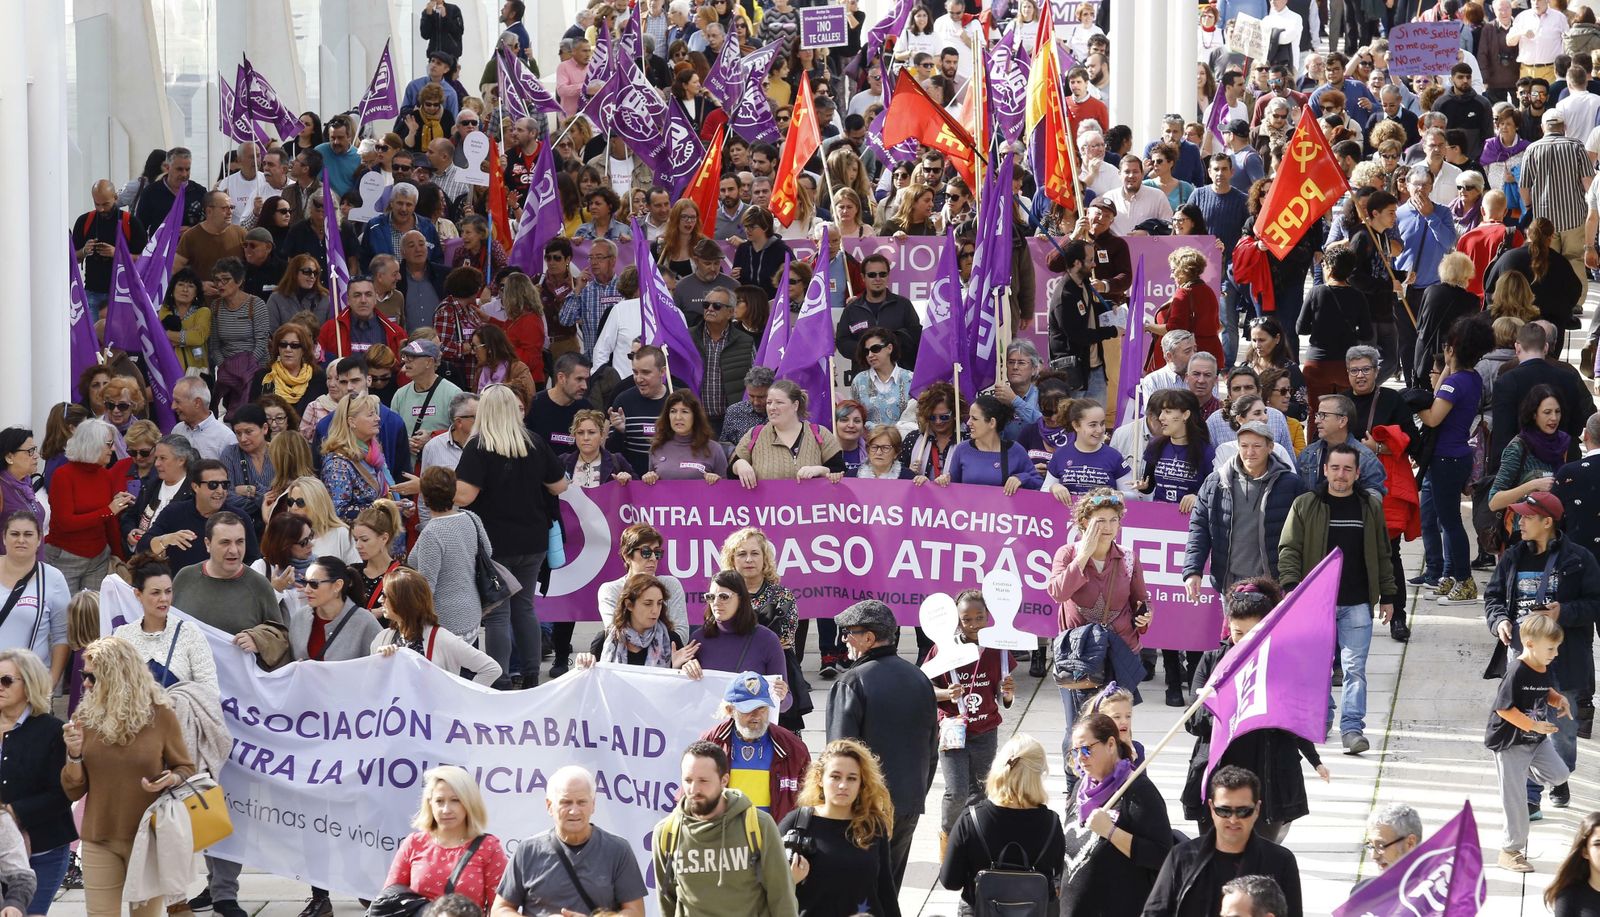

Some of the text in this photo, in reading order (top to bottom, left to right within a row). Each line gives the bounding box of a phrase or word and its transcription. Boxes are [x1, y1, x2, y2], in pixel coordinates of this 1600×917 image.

[816, 20, 831, 32] ¡NO
[1412, 27, 1429, 36] me
[808, 32, 841, 43] TE CALLES!
[1395, 55, 1408, 66] NO
[619, 503, 1054, 539] CONTRA LAS VIOLENCIAS MACHISTAS
[768, 534, 874, 577] ASO
[888, 537, 1053, 590] ATRÁS
[852, 588, 874, 601] LAS
[1156, 588, 1168, 601] la
[221, 697, 666, 758] ASOCIACIÓN ARRABAL-AID
[307, 759, 342, 784] LA
[596, 769, 680, 813] ACHIS
[314, 815, 342, 837] de
[672, 846, 749, 874] G.S.RAW
